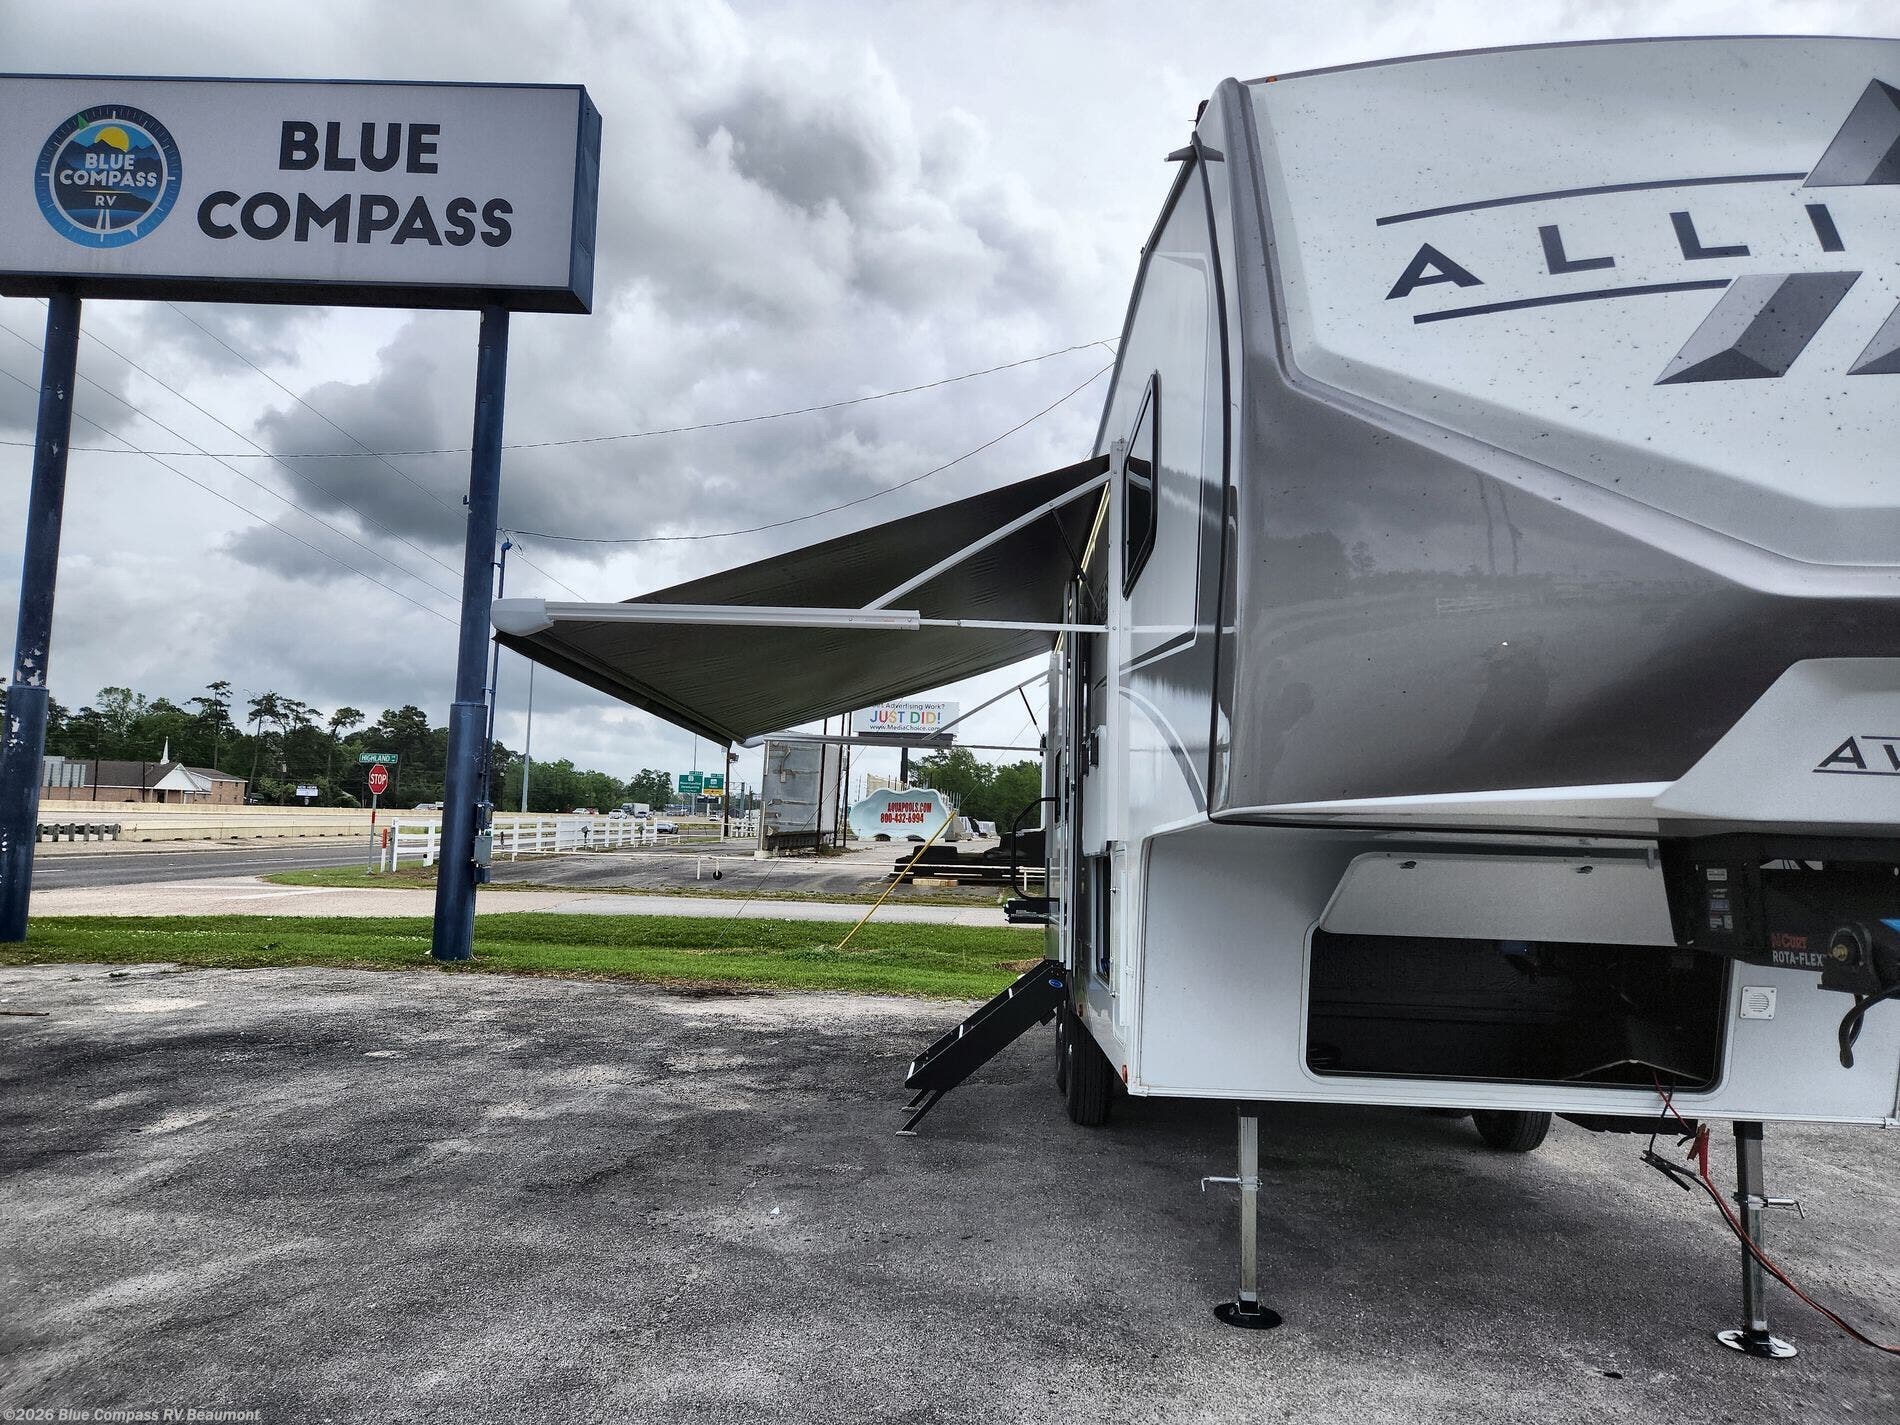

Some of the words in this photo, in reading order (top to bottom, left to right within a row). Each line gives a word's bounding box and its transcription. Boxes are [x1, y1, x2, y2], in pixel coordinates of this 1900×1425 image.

[279, 120, 442, 175] BLUE
[85, 153, 135, 170] BLUE
[60, 169, 158, 188] COMPASS
[95, 195, 117, 207] RV
[197, 190, 514, 249] COMPASS
[885, 702, 923, 711] Advertising
[870, 711, 905, 724] JUST
[910, 711, 941, 724] DID!
[370, 774, 386, 785] STOP
[1773, 951, 1824, 967] ROTA-FLEX
